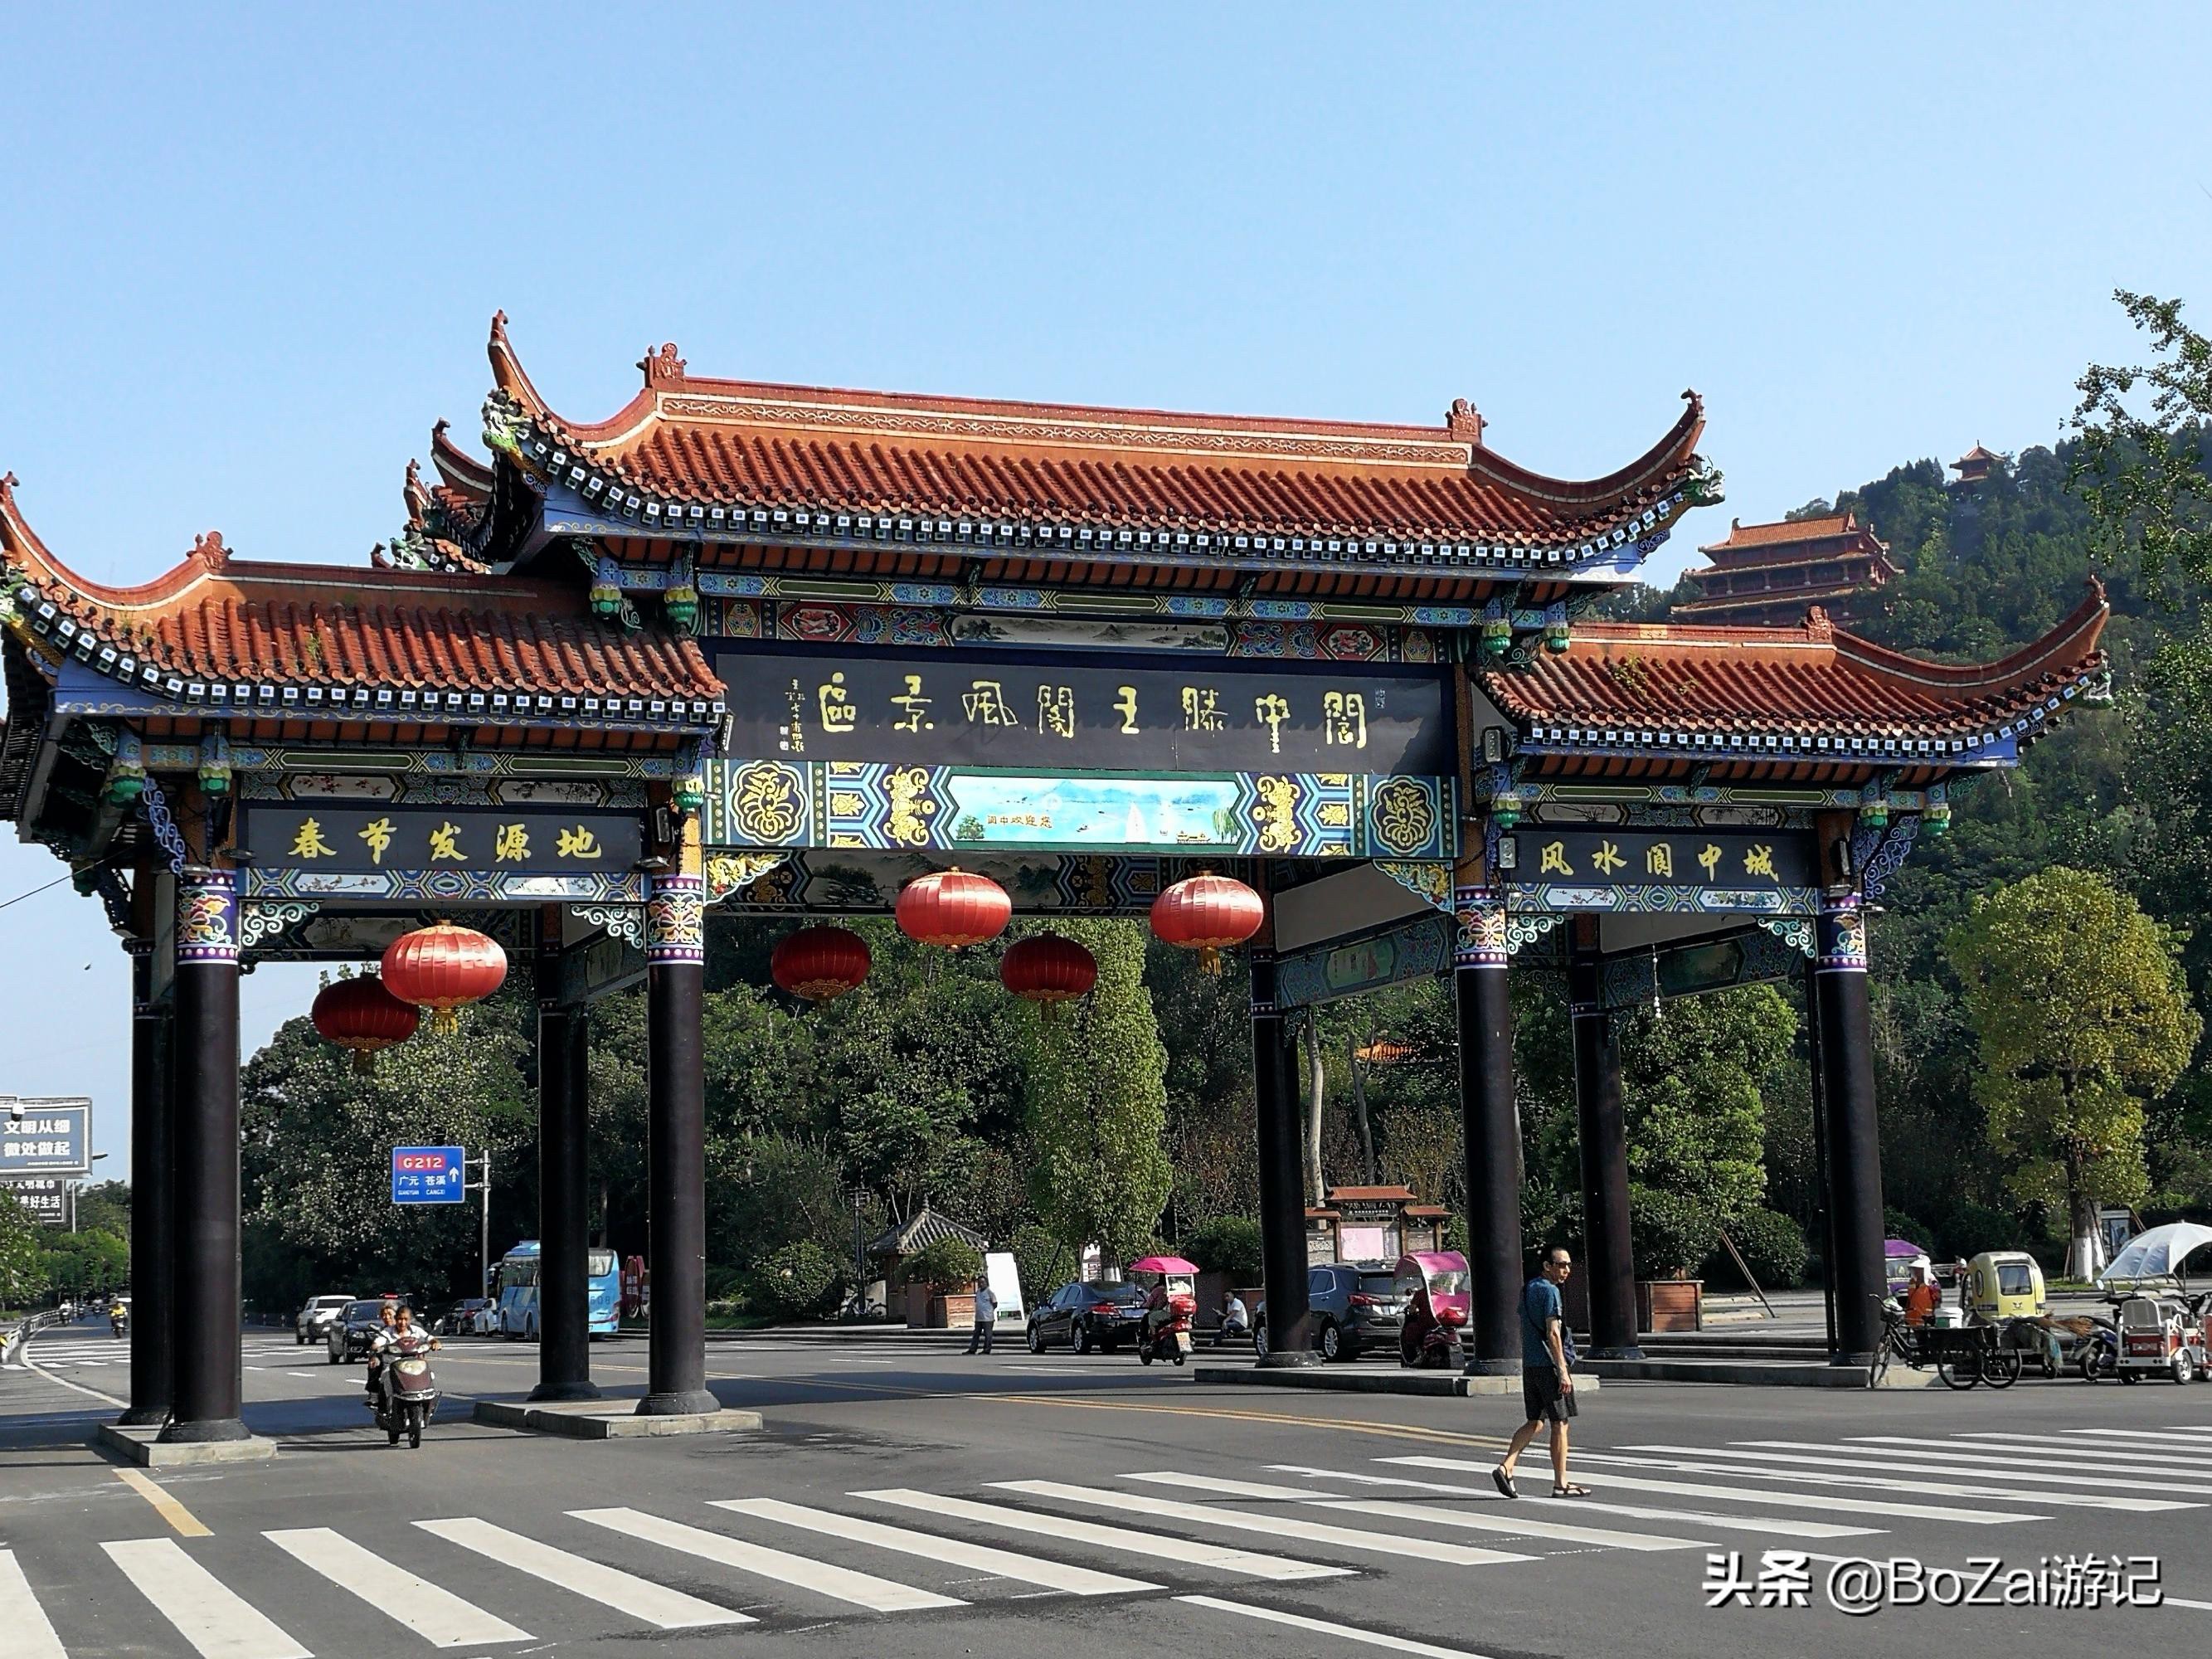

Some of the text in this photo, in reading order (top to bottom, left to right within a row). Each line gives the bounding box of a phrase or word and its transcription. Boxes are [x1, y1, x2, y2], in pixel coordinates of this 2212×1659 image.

[288, 817, 601, 863] 春节发源地
[3, 1119, 70, 1134] 文明从细
[3, 1141, 70, 1157] 微处做起
[403, 1157, 443, 1169] G212
[399, 1175, 446, 1186] 广元 苍溪
